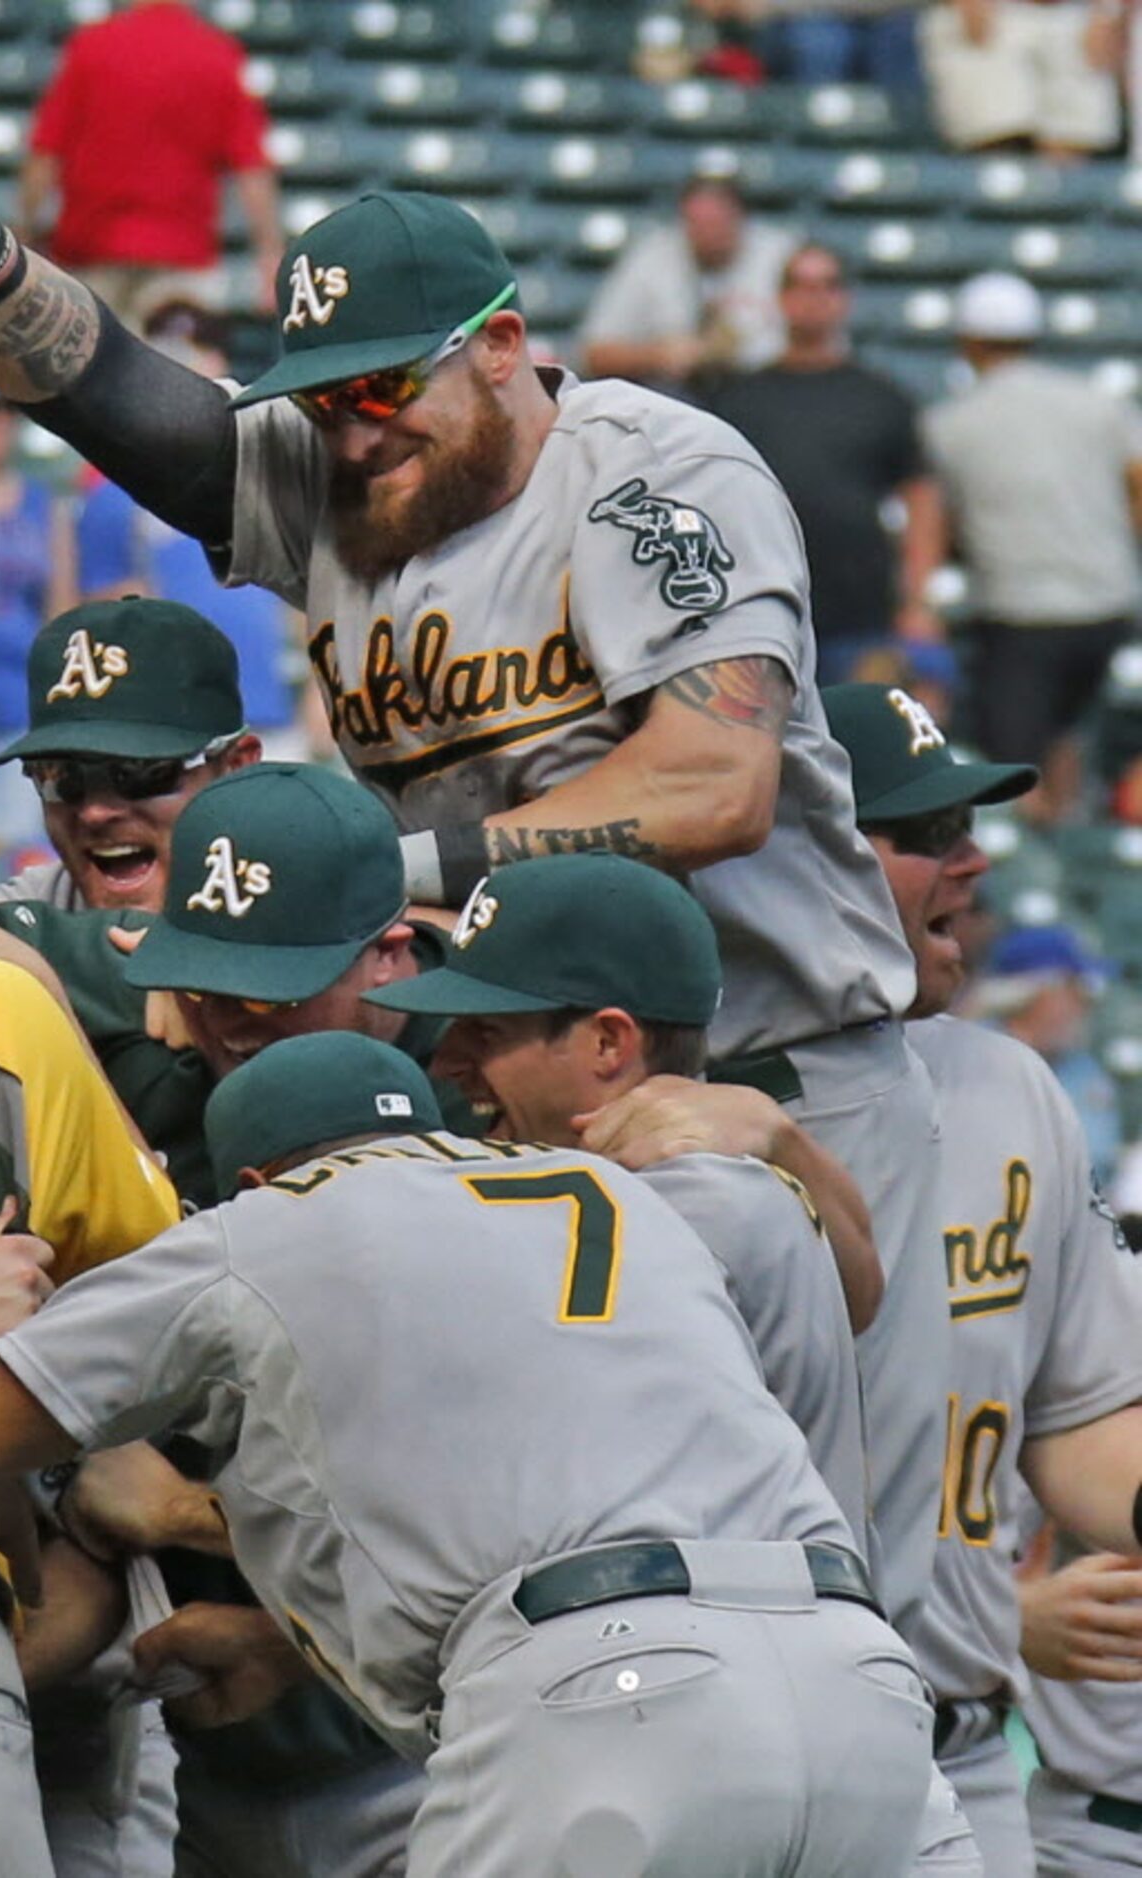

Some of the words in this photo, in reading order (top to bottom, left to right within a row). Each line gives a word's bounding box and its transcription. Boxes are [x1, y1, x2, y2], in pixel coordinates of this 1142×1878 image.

[283, 254, 349, 334] A's
[47, 629, 129, 703] A's
[187, 836, 272, 917] A's
[462, 1165, 626, 1324] 7
